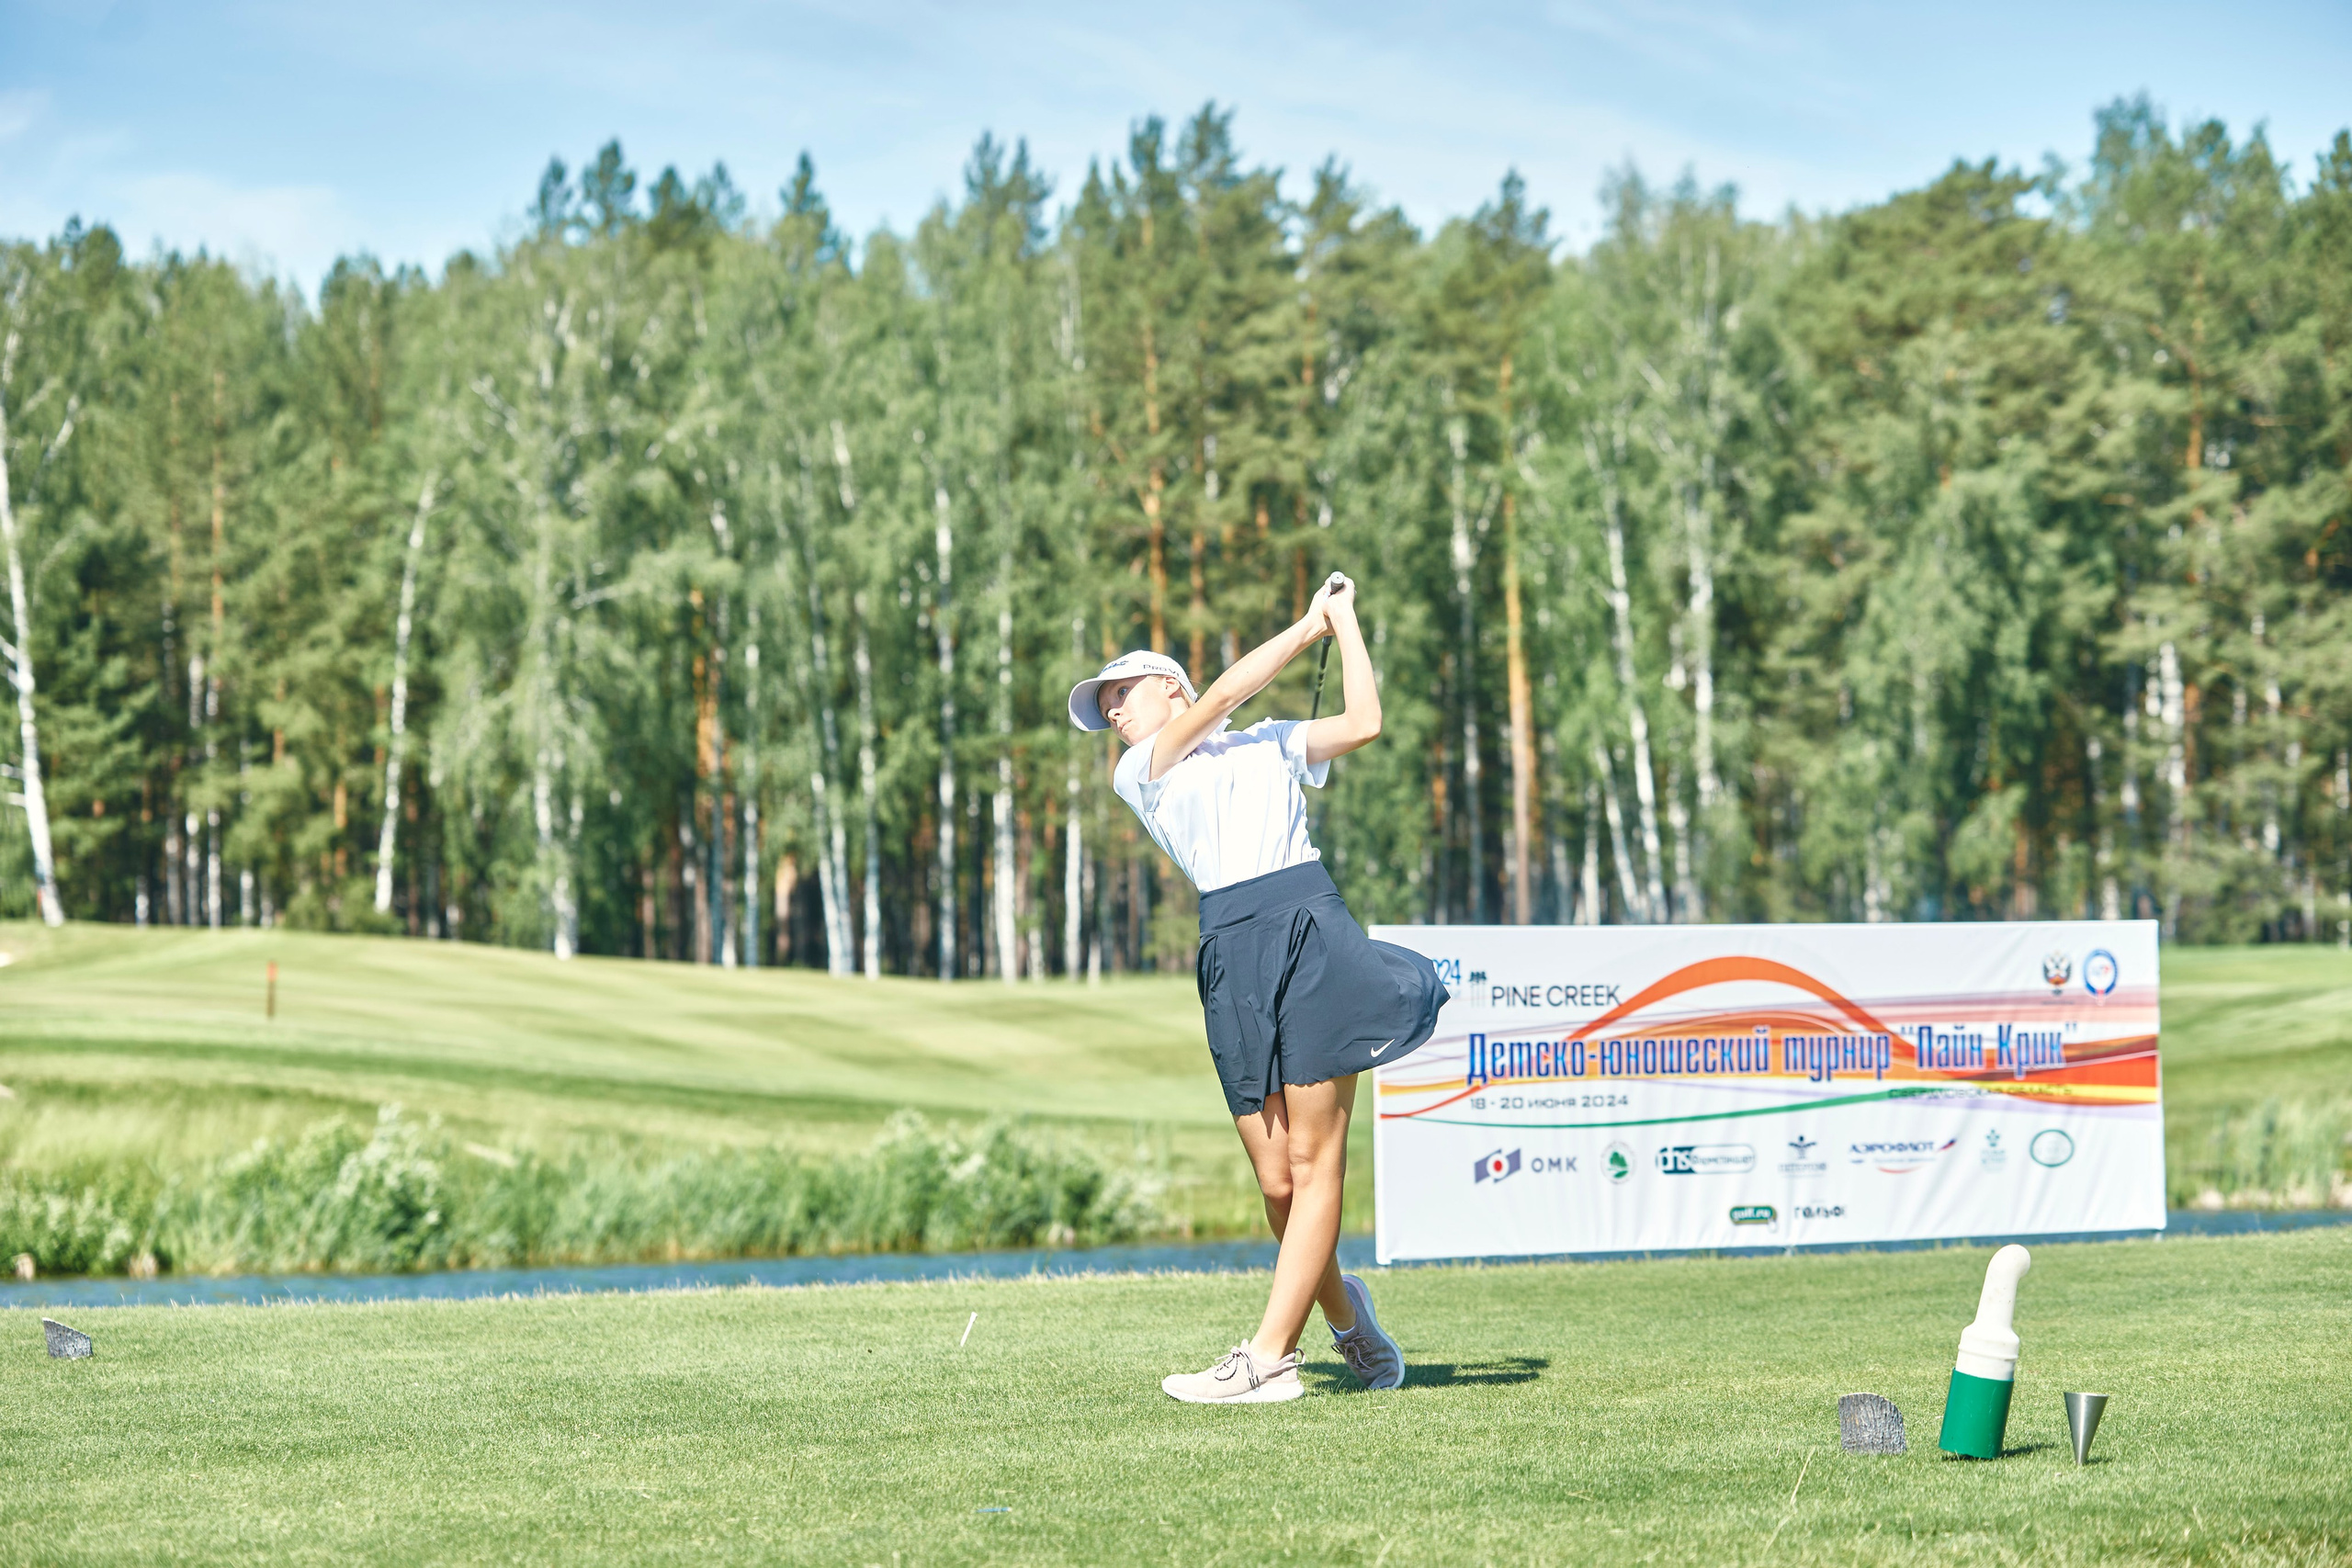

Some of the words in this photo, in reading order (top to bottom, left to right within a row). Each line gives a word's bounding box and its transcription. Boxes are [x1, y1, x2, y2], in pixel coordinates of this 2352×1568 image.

[1491, 986, 1541, 1007] PINE
[1546, 985, 1623, 1007] CREEK
[1466, 1024, 1770, 1087] Детско-юношеский
[1782, 1032, 1891, 1083] турнир
[1470, 1098, 1487, 1110] 18
[1500, 1097, 1523, 1109] 20
[1581, 1095, 1629, 1108] 2024
[1531, 1156, 1578, 1174] ОМК
